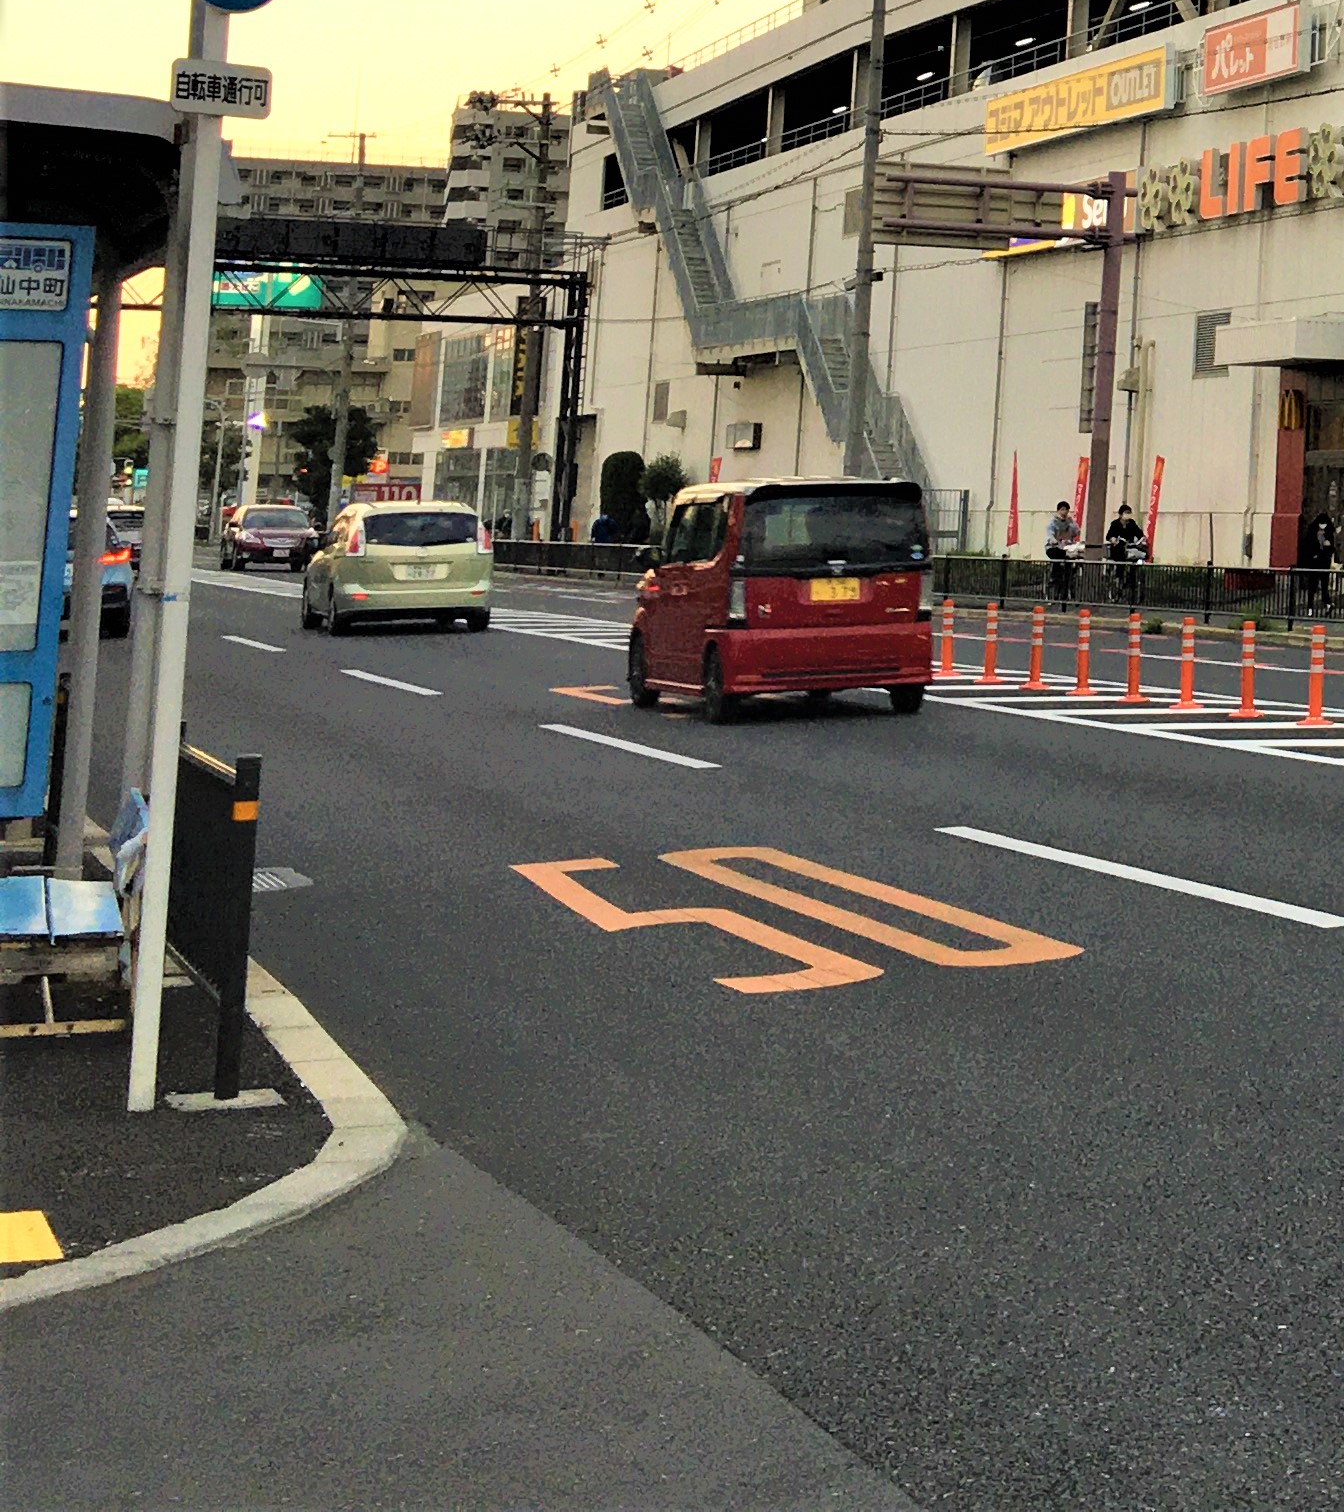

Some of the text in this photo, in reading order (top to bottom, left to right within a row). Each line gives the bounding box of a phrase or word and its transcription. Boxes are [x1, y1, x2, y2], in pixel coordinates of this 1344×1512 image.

[176, 70, 269, 108] 自転車通行可
[1211, 32, 1255, 80] パレット
[1028, 73, 1105, 129] アウトレット
[1110, 63, 1158, 106] OUTLET
[1199, 126, 1302, 220] LIFE
[508, 846, 1086, 994] 50
